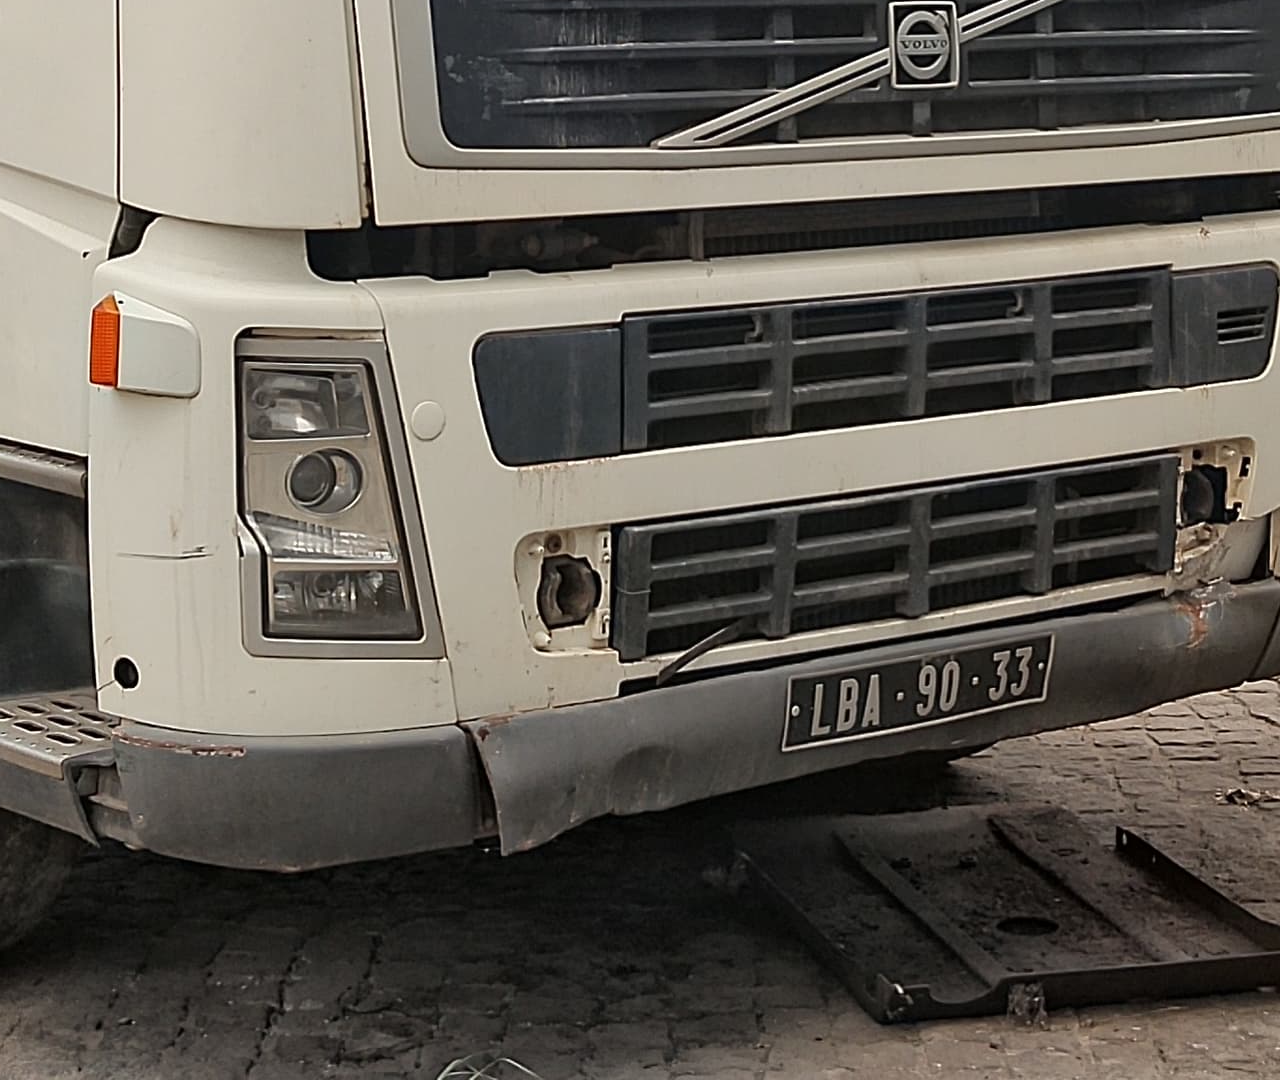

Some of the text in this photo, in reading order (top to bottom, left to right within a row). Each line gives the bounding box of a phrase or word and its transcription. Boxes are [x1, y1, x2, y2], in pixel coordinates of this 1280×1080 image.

[900, 40, 948, 50] VOLVO
[810, 646, 1033, 737] LBA 90 33
